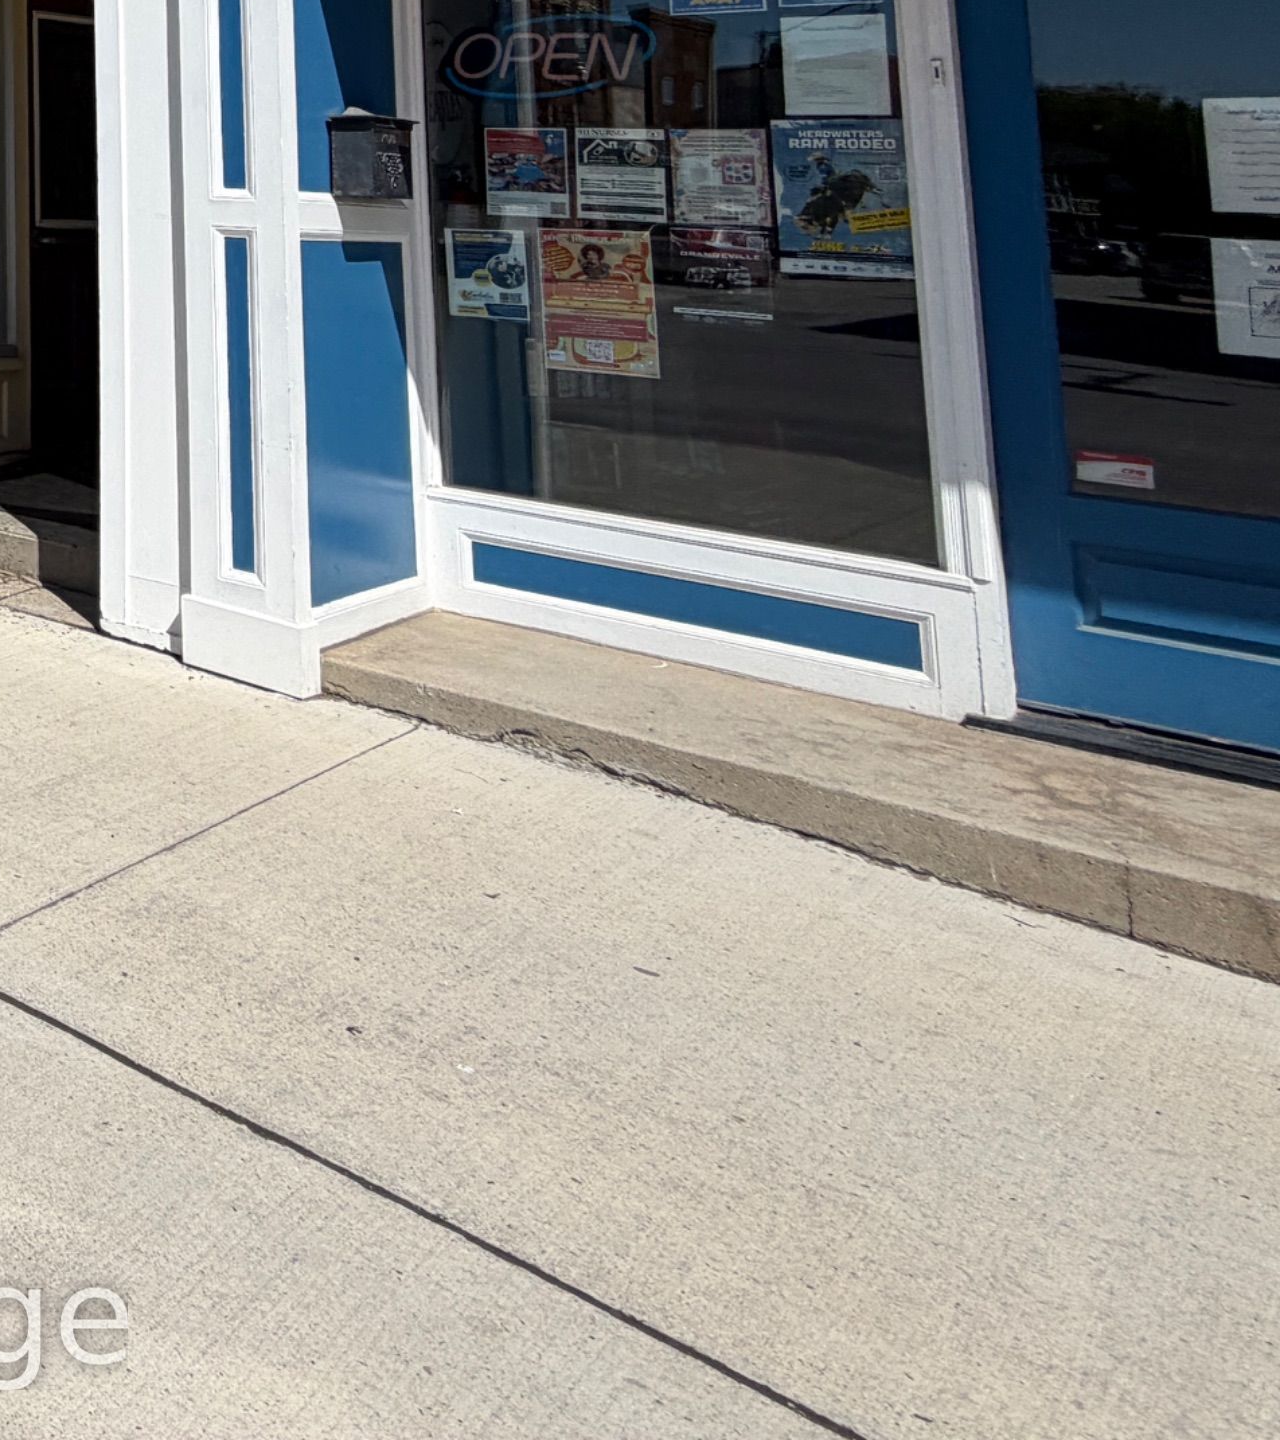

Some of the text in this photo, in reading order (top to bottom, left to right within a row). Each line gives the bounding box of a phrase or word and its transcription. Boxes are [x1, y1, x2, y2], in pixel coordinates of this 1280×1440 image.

[454, 32, 638, 81] OPEN
[797, 129, 884, 138] HEADWATERS
[789, 138, 897, 149] RAM RODEO
